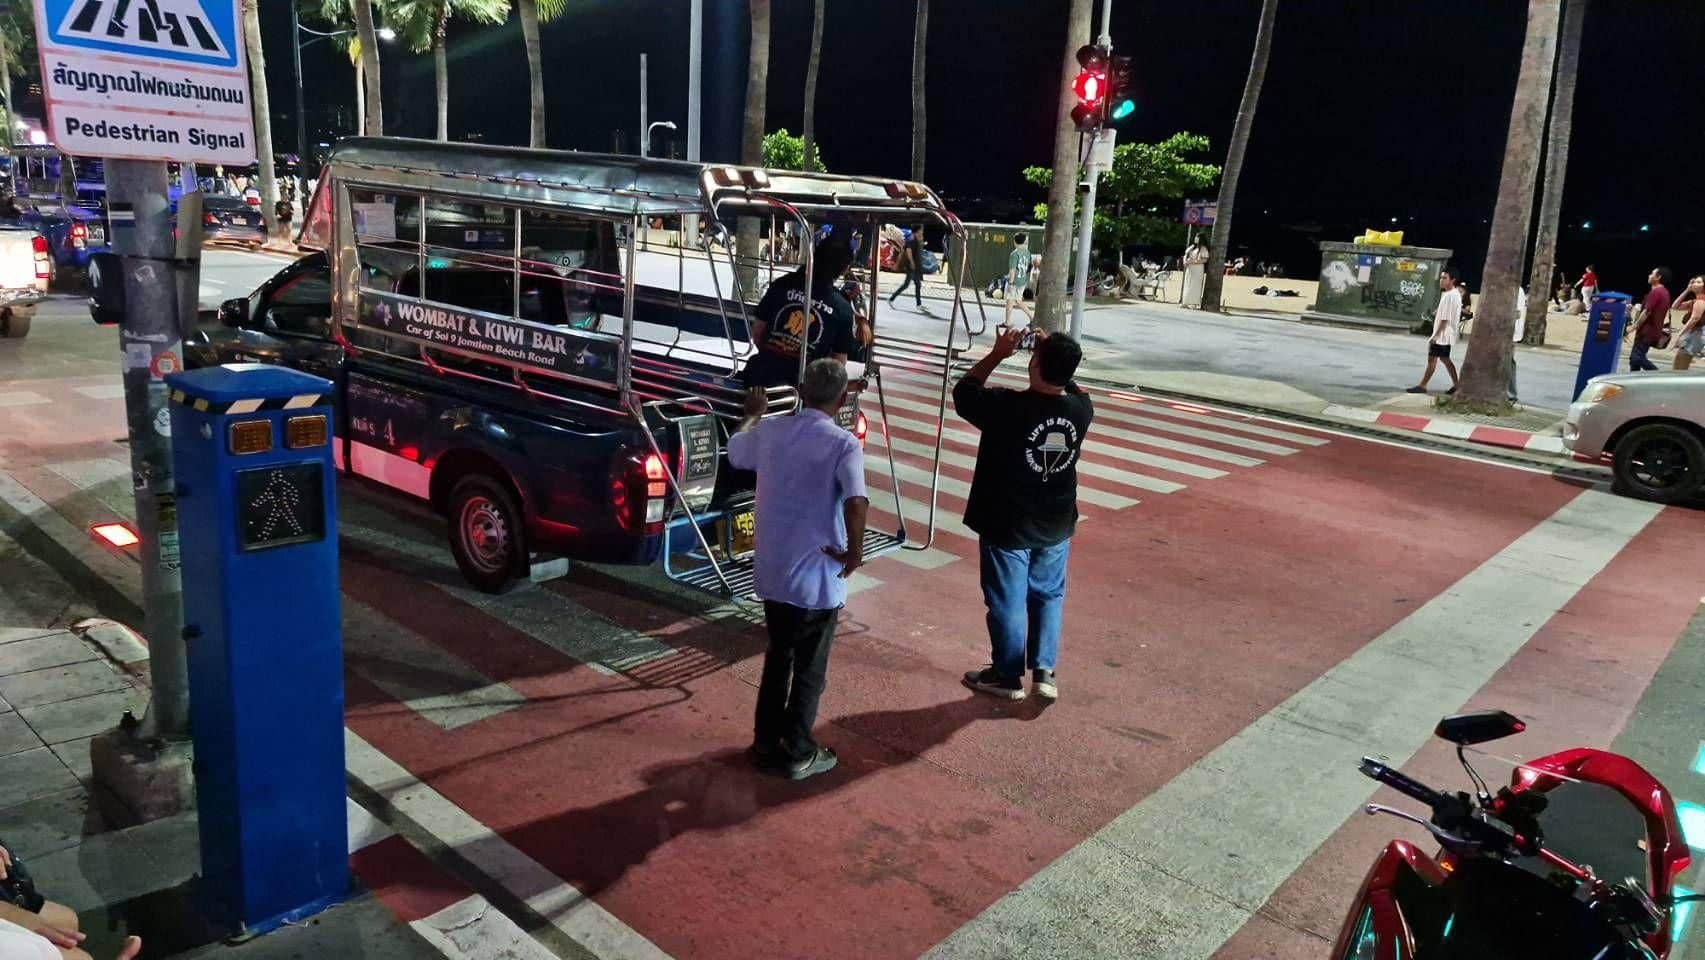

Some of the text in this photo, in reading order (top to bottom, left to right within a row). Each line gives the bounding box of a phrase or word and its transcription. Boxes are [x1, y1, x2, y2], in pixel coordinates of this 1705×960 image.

[53, 62, 244, 104] สัญญาณไฟคนข้ามถนน
[65, 117, 245, 150] Pedestrian Signal
[398, 302, 568, 355] WOMBAT & KIWI BAR
[424, 327, 435, 339] of
[435, 330, 449, 342] Soi
[450, 335, 456, 343] 9
[457, 336, 494, 352] Jomtien
[495, 344, 526, 359] Beach
[528, 351, 556, 366] Road
